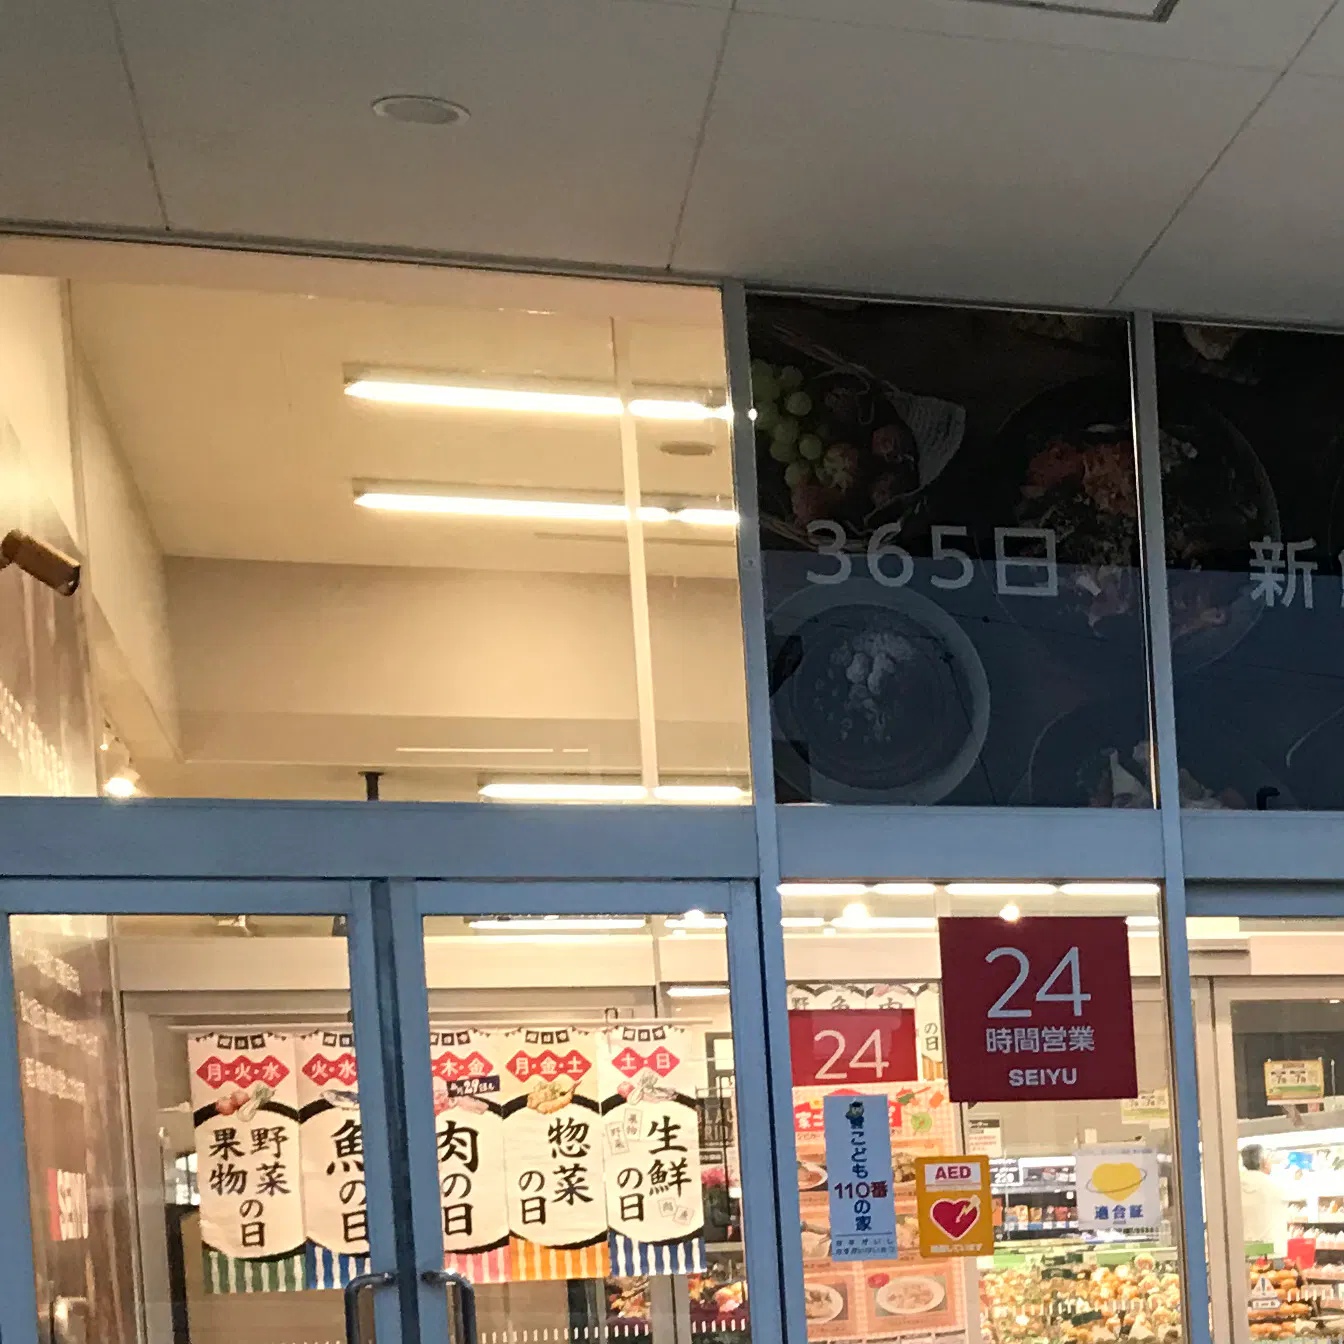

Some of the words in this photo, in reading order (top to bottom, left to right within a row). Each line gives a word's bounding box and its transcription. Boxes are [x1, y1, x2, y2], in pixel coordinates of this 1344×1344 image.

[806, 519, 1059, 597] 365日
[985, 945, 1092, 1019] 24
[516, 1056, 584, 1076] 月・金・土
[621, 1053, 670, 1073] 土・日
[814, 1028, 890, 1080] 24
[985, 1025, 1096, 1054] 時間営業
[207, 1063, 282, 1082] 月・火・水
[1008, 1068, 1078, 1087] SEIYU
[208, 1126, 249, 1197] 果物
[250, 1125, 291, 1197] 野菜
[436, 1119, 480, 1237] 肉の日
[548, 1116, 595, 1206] 惣菜
[647, 1115, 693, 1198] 生鮮
[934, 1165, 972, 1181] AED
[518, 1170, 547, 1225] の日
[616, 1167, 645, 1222] の日
[1094, 1203, 1144, 1220] 適合証
[239, 1198, 267, 1248] の日
